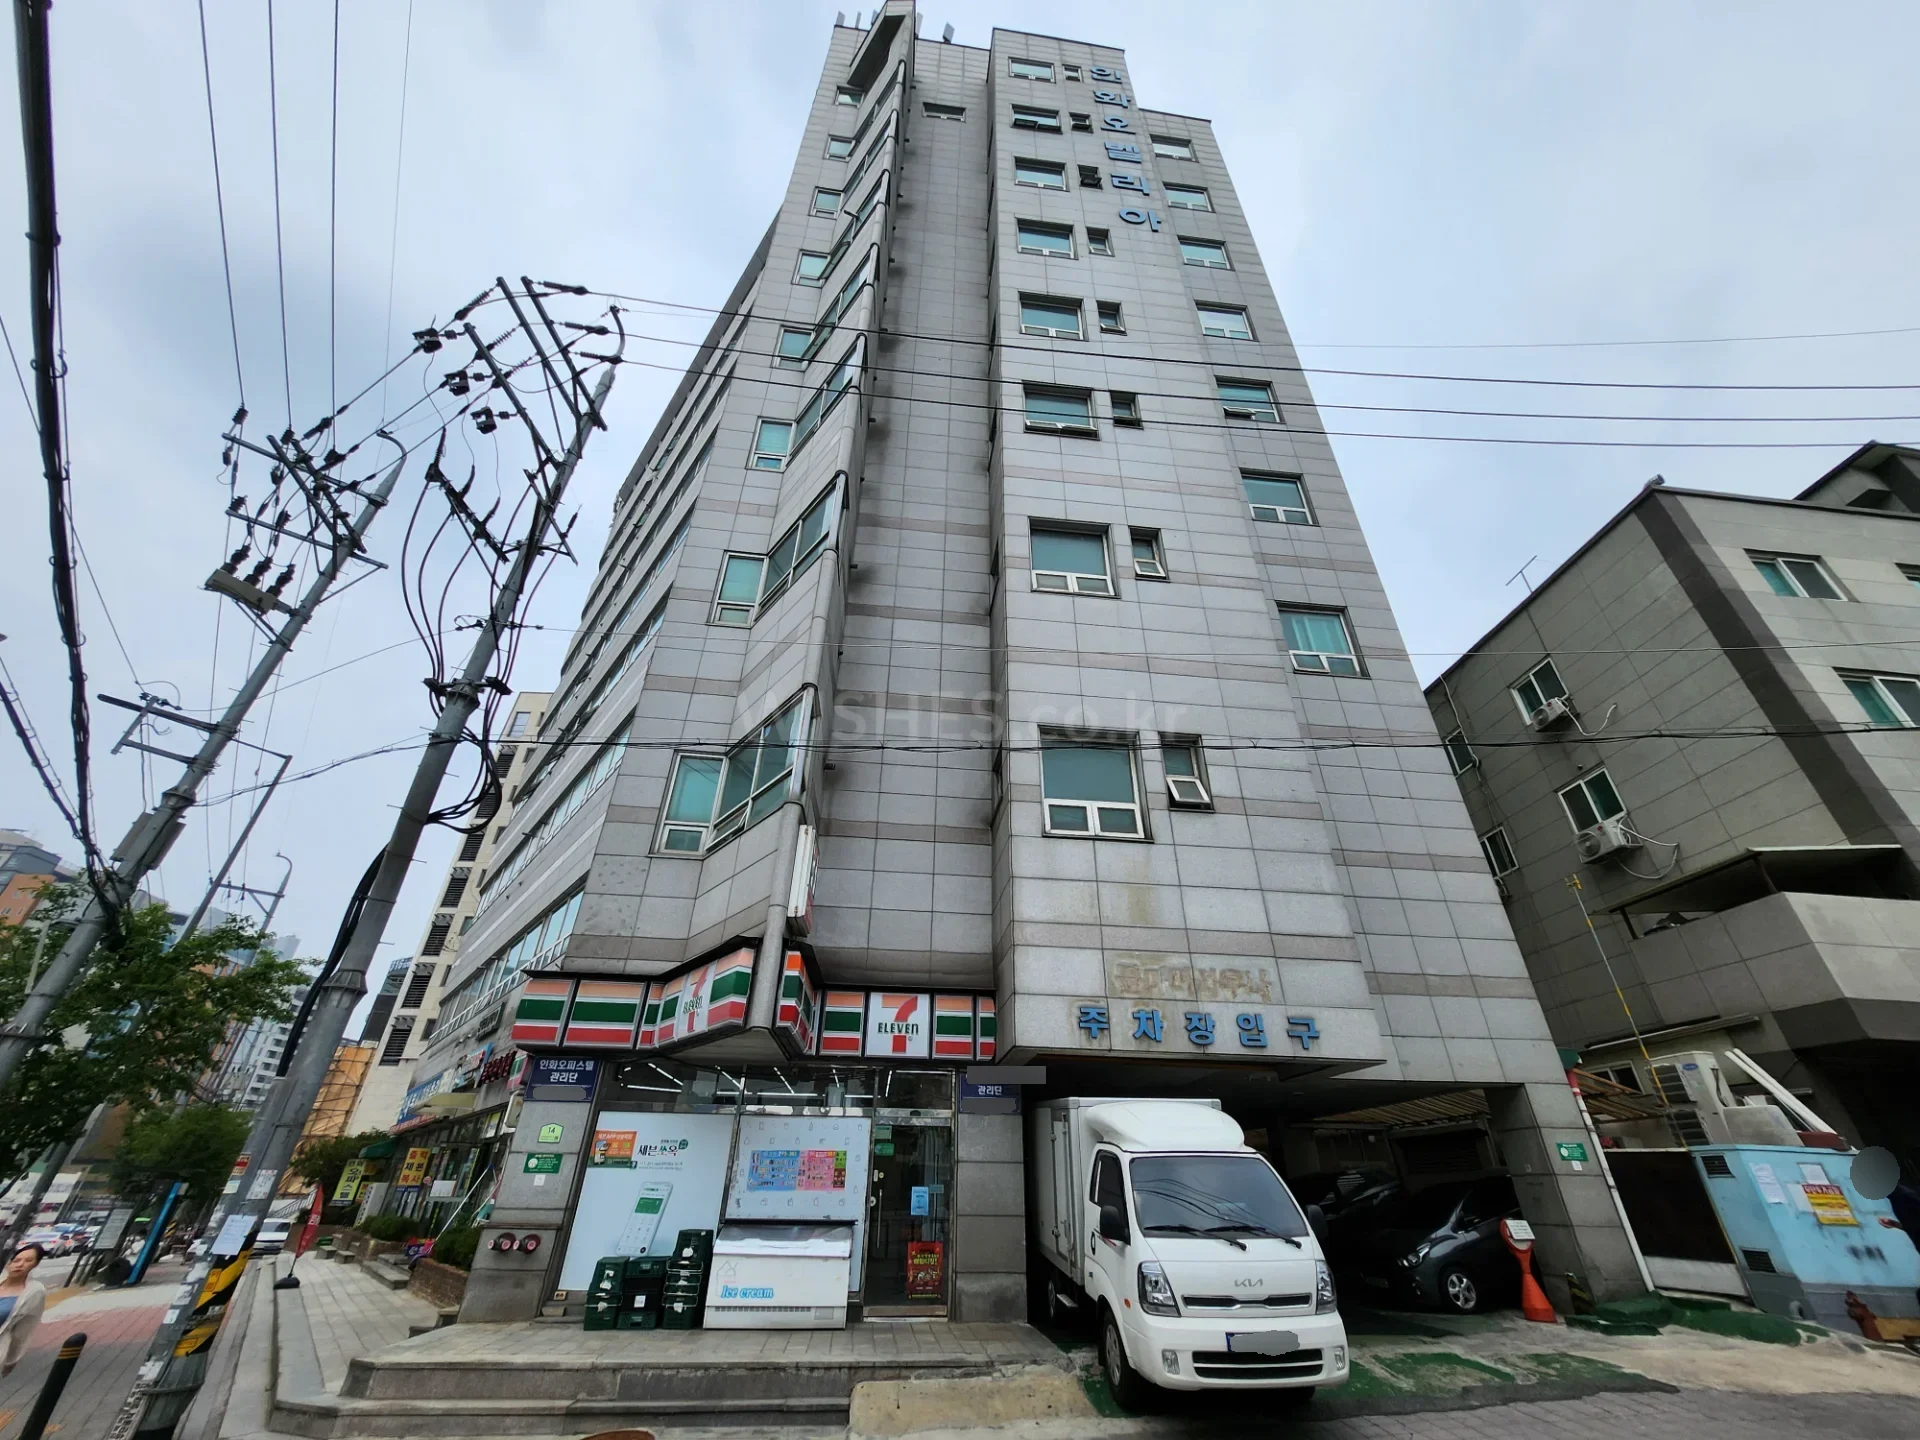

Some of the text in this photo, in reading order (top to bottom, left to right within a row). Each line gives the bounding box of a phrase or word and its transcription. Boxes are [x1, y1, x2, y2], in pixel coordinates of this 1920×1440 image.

[881, 994, 918, 1054] 7
[1079, 1007, 1320, 1049] 주차장입구
[540, 1060, 594, 1071] 인화오피스텔
[550, 1072, 578, 1082] 관리단
[977, 1085, 1003, 1095] 관리단
[721, 1285, 774, 1298] Ice cream
